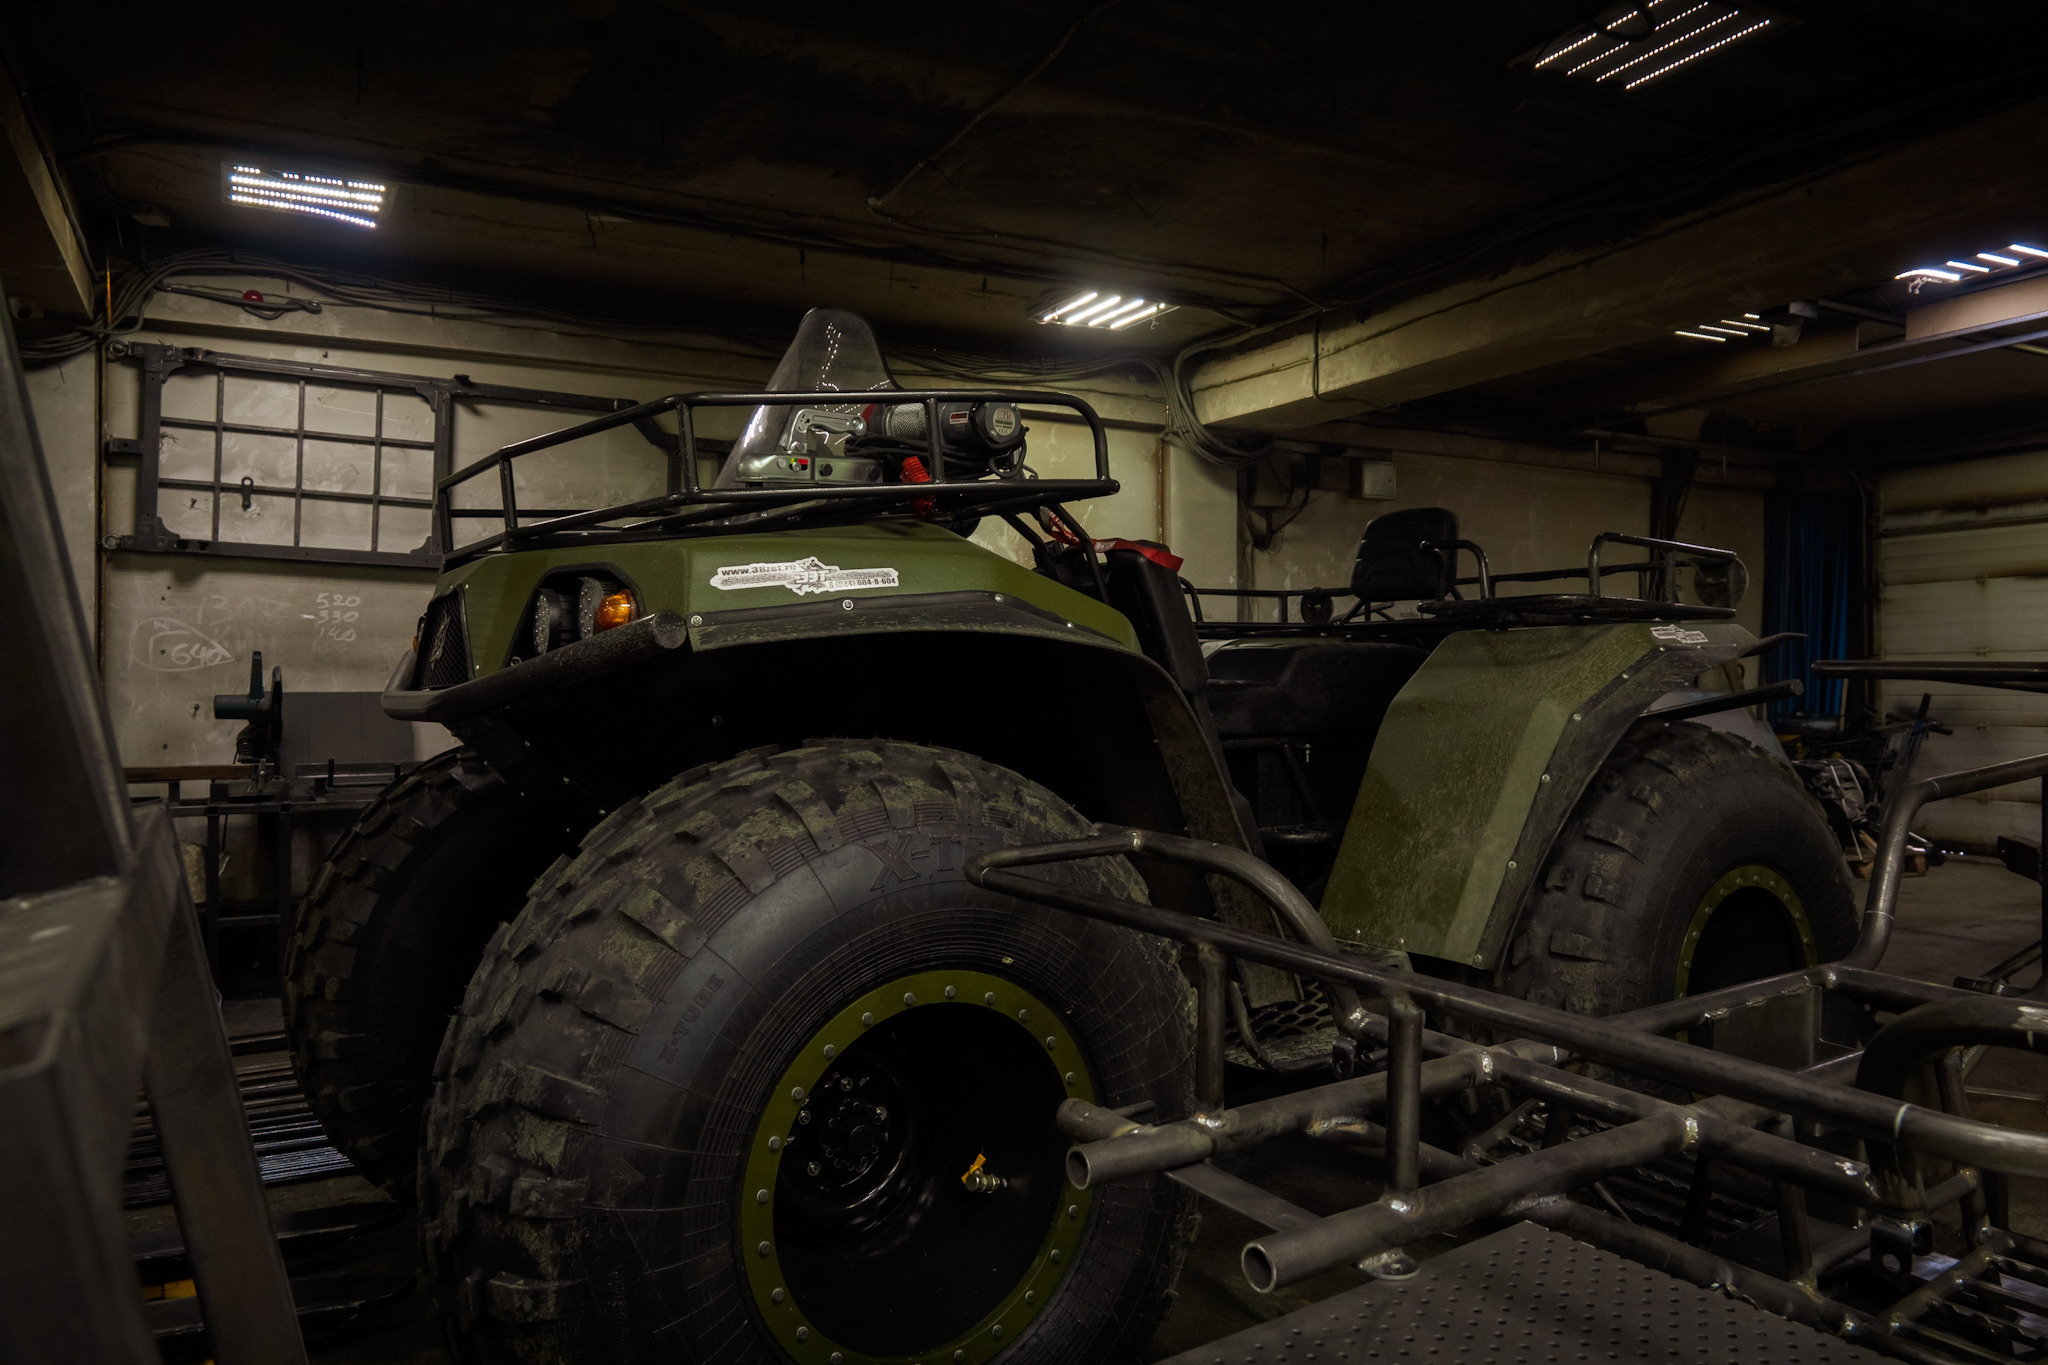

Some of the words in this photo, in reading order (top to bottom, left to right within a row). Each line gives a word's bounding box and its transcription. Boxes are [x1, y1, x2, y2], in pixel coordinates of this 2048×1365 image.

[316, 592, 361, 609] 520
[170, 643, 222, 667] 640
[657, 973, 726, 1065] X-TUBE
